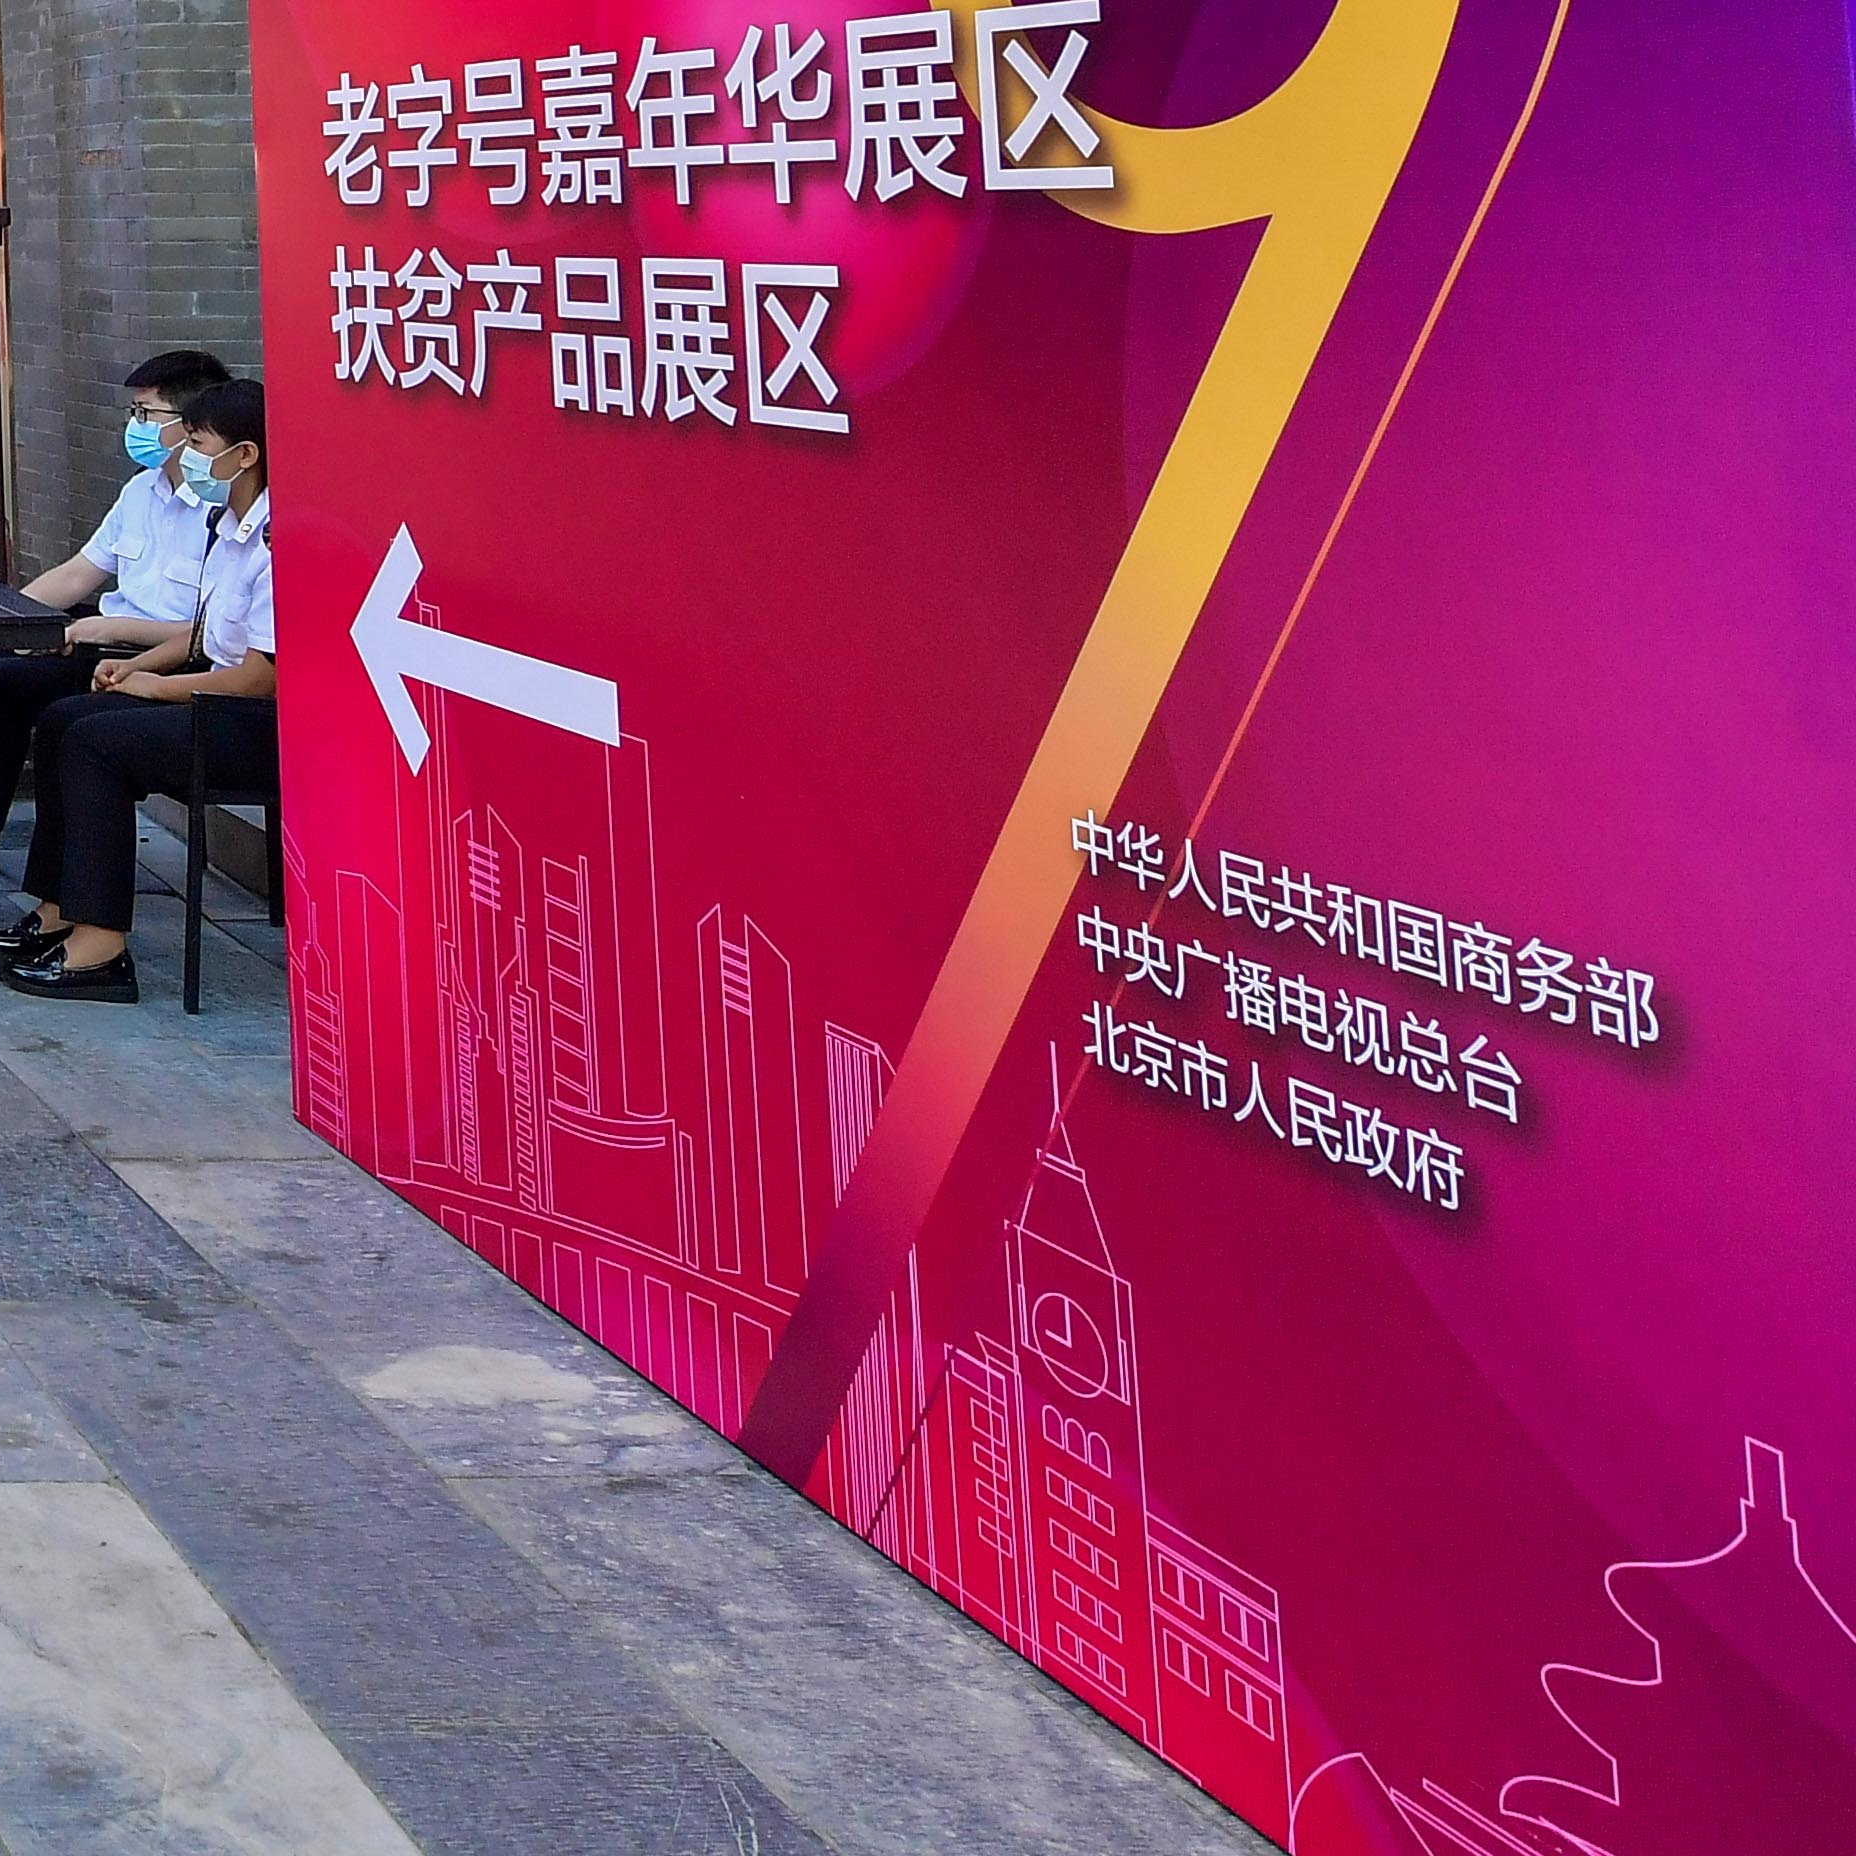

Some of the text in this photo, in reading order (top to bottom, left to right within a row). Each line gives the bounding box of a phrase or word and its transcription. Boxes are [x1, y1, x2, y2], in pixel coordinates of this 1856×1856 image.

[329, 245, 850, 436] 扶贫产品展区
[1071, 809, 1660, 1048] 中华人民共和国商务部
[1078, 906, 1523, 1123] 中央广播电视总台
[1082, 1000, 1464, 1211] 北京市人民政府
